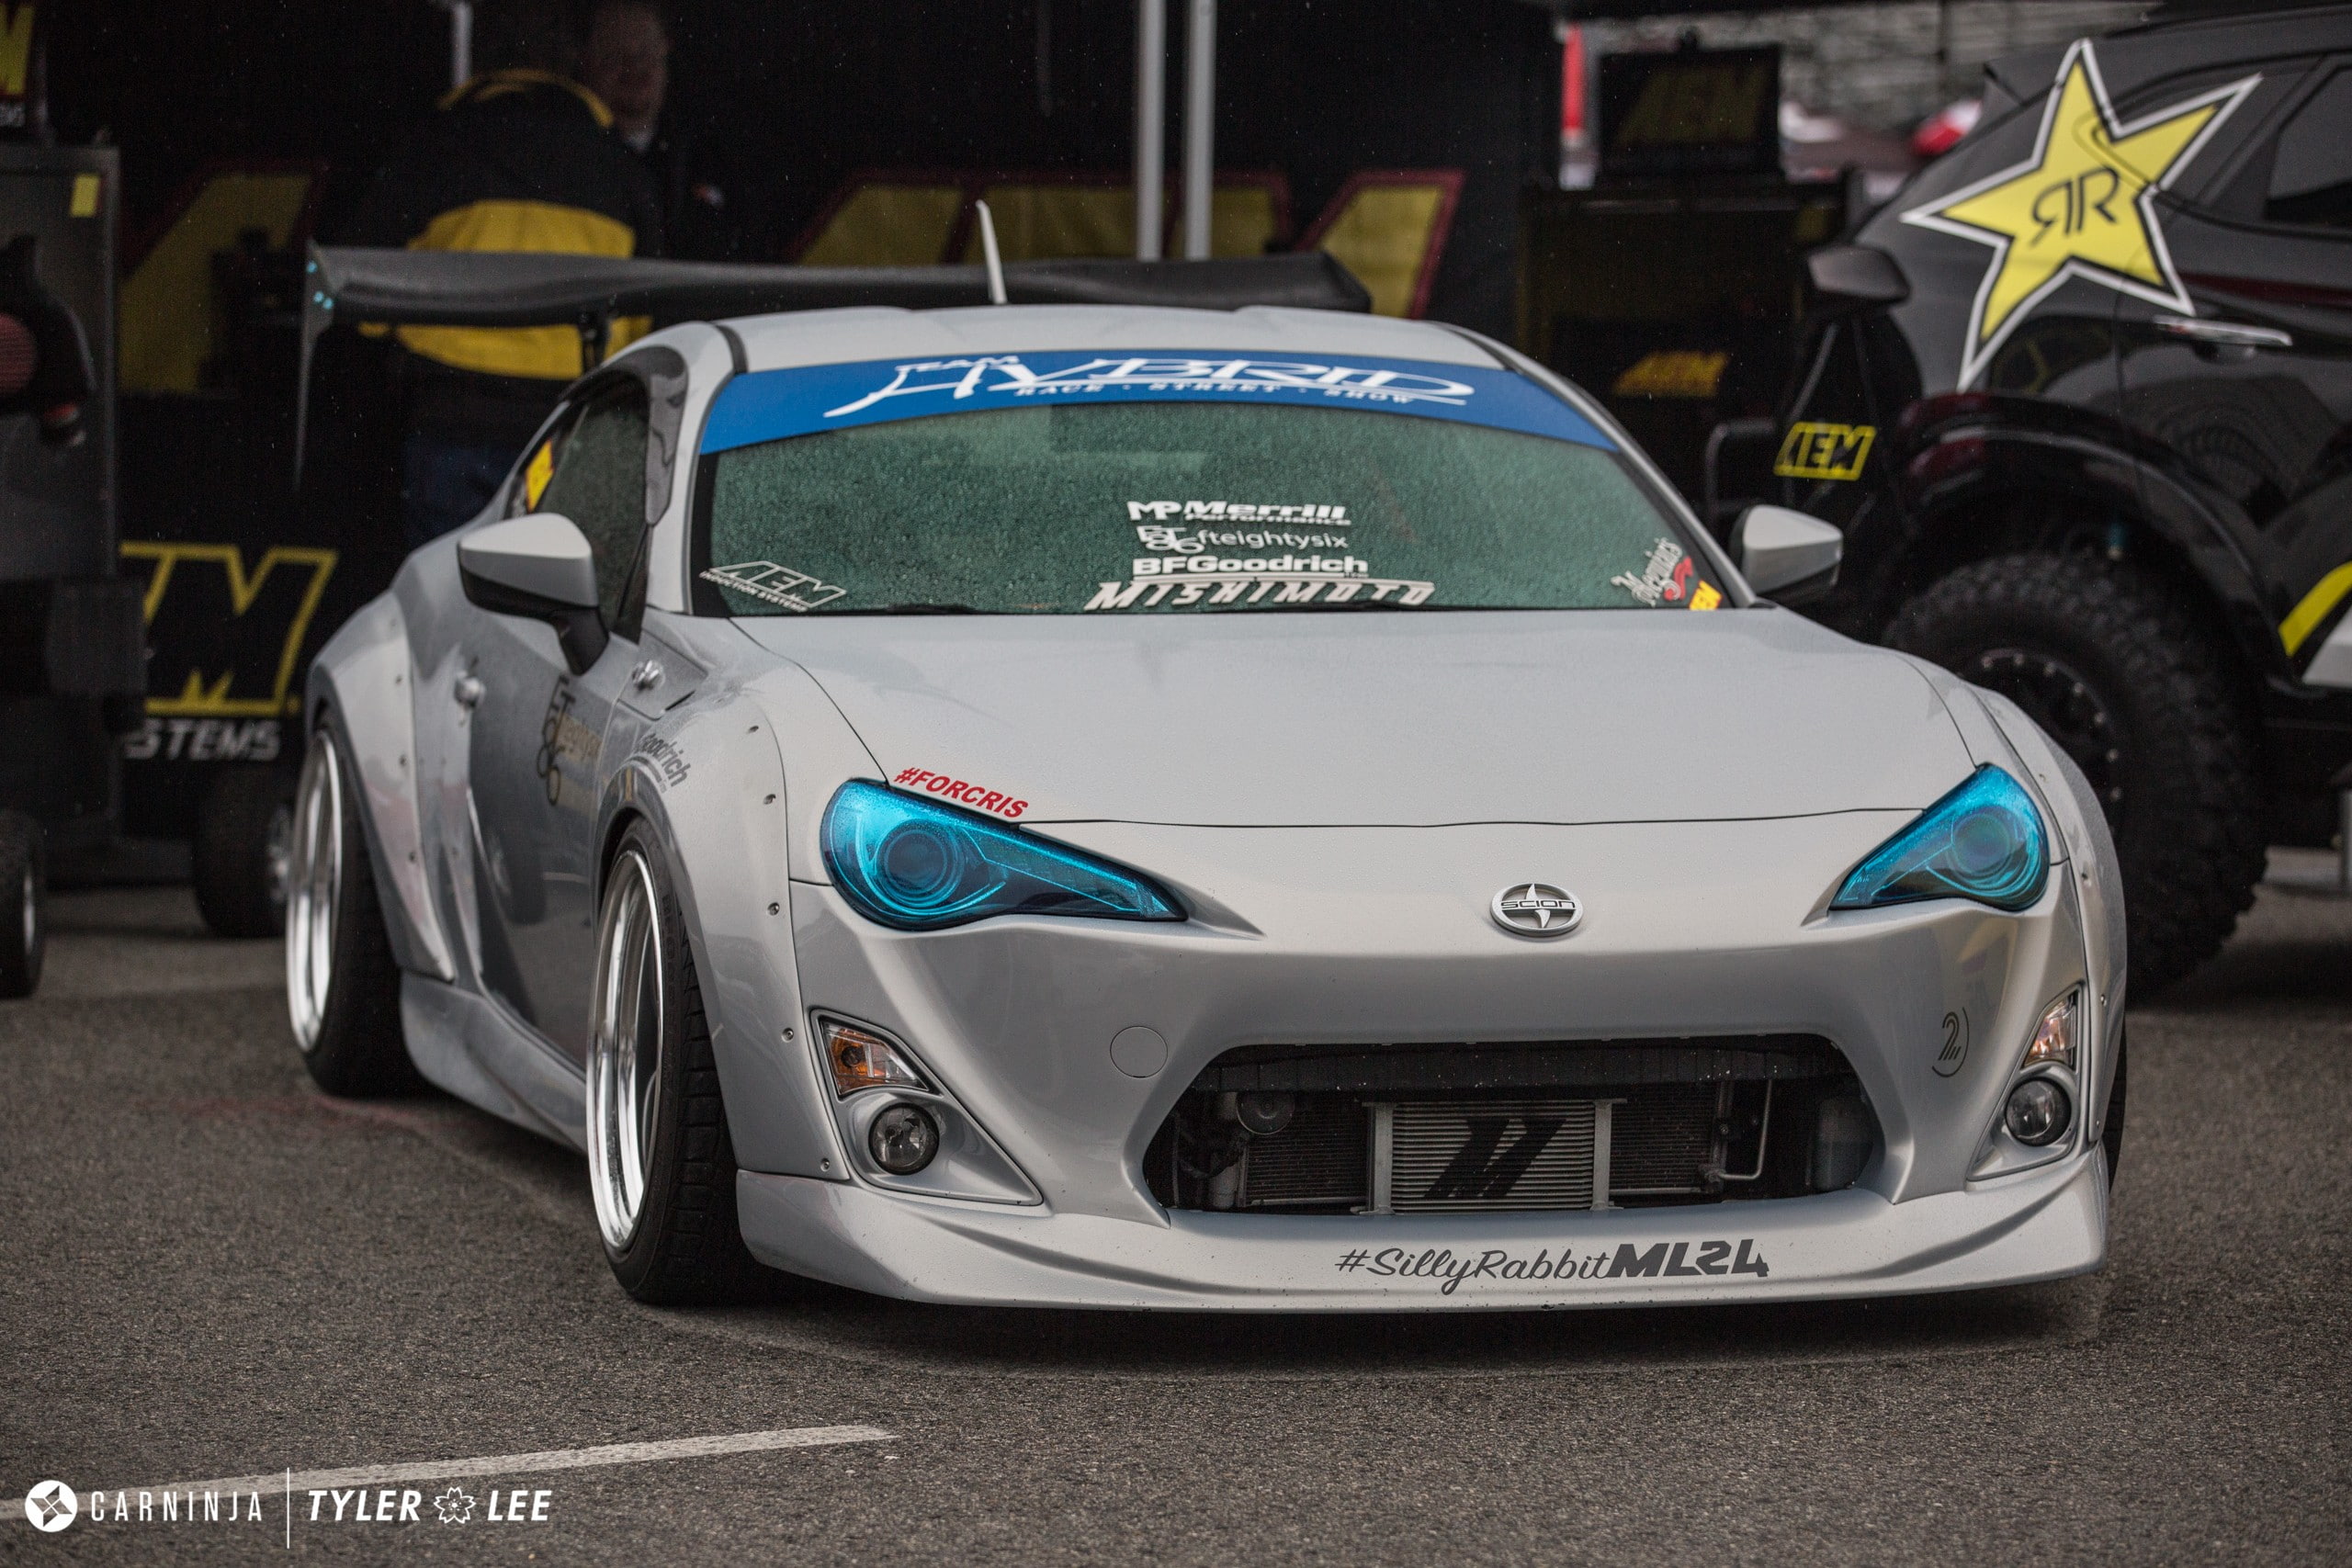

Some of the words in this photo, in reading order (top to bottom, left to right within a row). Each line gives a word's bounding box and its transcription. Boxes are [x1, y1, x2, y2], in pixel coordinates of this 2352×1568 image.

[1148, 382, 1282, 393] STREET
[1324, 389, 1416, 405] SHOW
[1183, 500, 1347, 521] Merrill
[1132, 555, 1369, 576] BFGoodrich
[708, 560, 847, 608] AEM
[1083, 577, 1436, 612] MISHIMOTO
[124, 719, 281, 761] STEMS
[893, 767, 1029, 818] #FORCRIS
